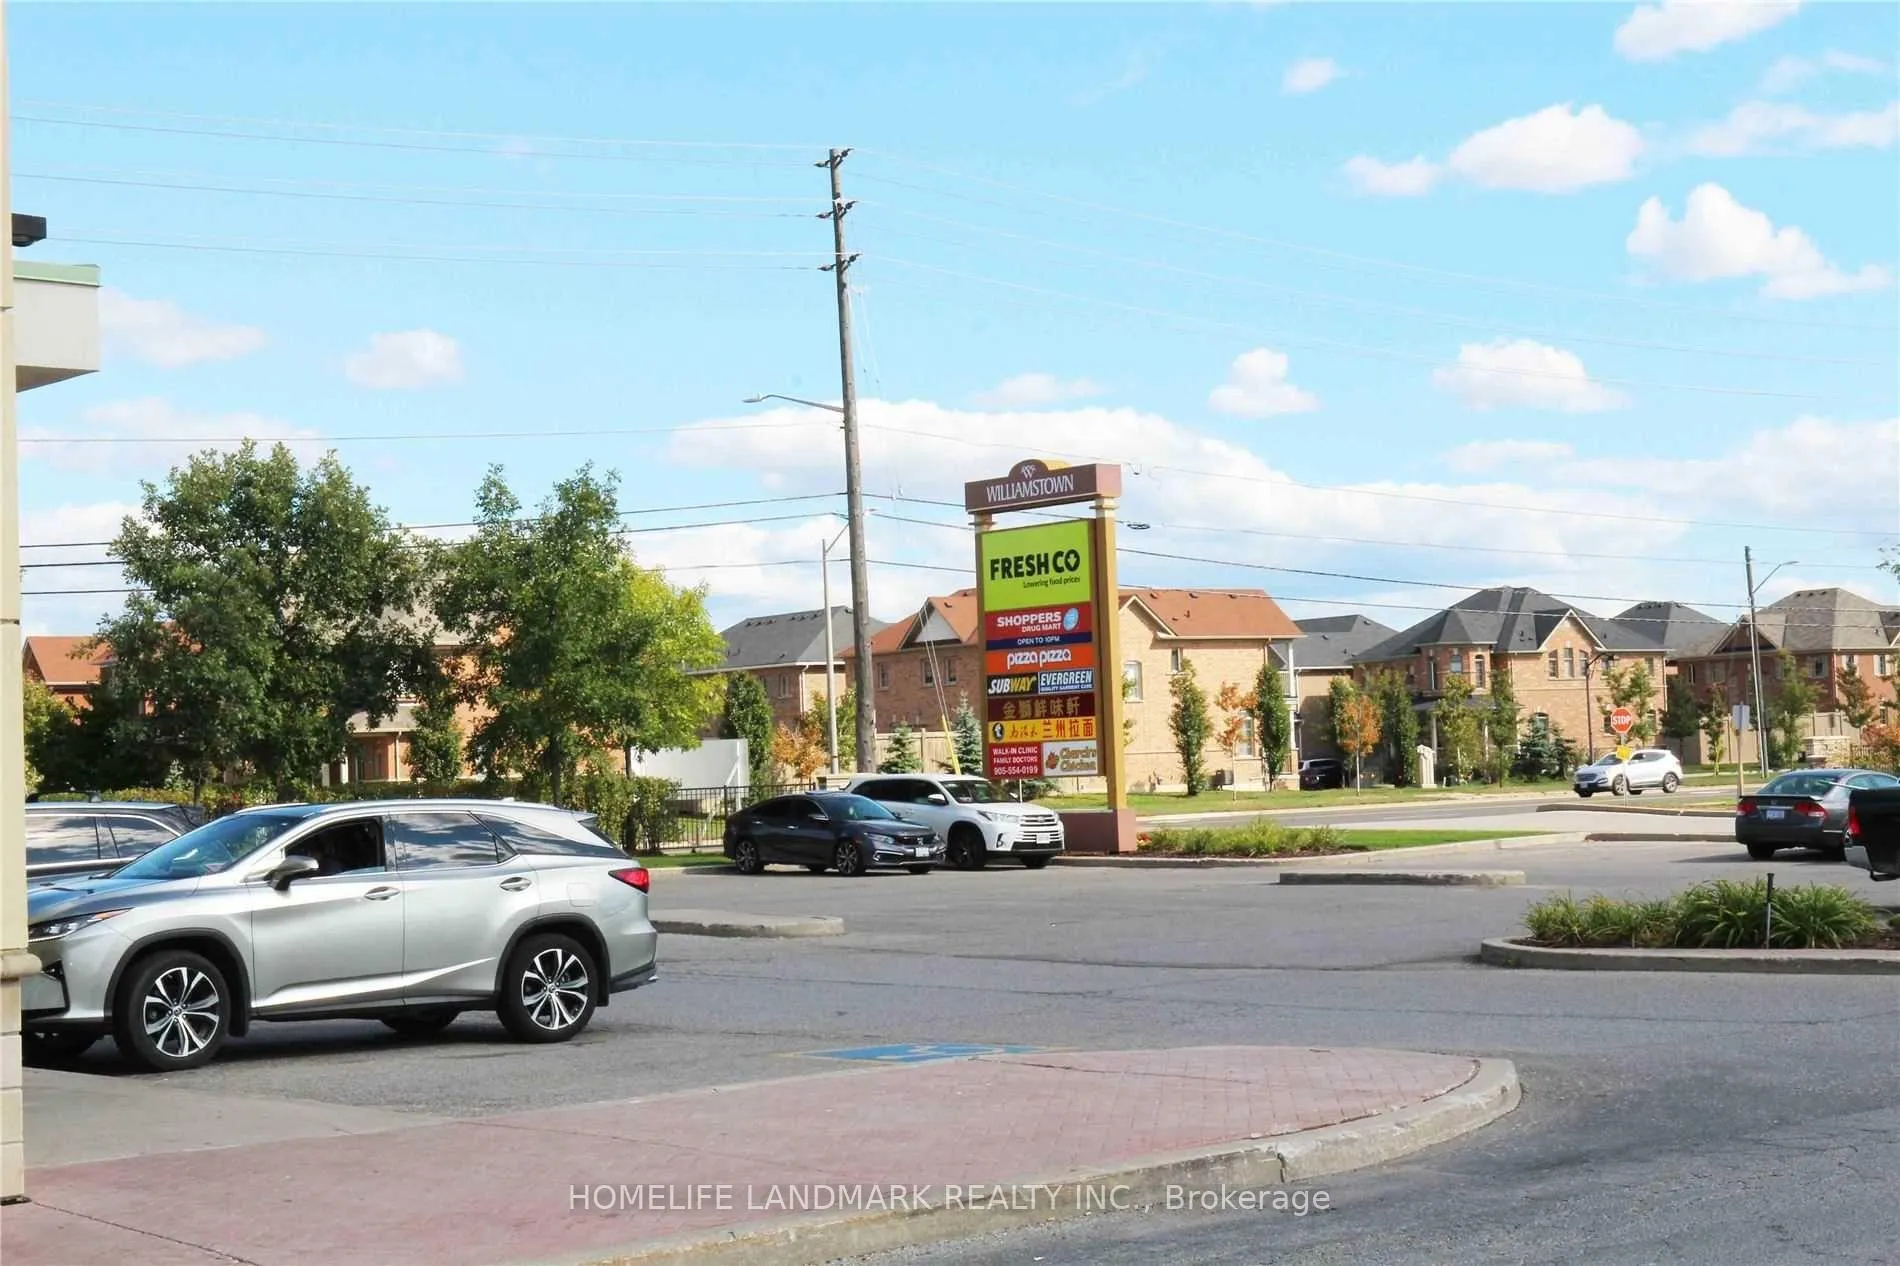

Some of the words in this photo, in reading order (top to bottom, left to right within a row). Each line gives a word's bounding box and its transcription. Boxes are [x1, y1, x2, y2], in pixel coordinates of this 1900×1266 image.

[986, 474, 1074, 503] WILLIAMSTOWN
[1023, 578, 1049, 588] Lowering
[1063, 576, 1080, 586] prices
[997, 611, 1062, 627] SHOPPERS
[1022, 624, 1041, 633] DRUG
[1042, 623, 1061, 631] MART
[1017, 637, 1034, 645] OPEN
[1035, 636, 1044, 644] TO
[1007, 651, 1038, 669] pizza
[1040, 648, 1071, 667] pizza
[988, 675, 1036, 695] SUBWAY
[1041, 670, 1092, 685] EVERGREEN
[1612, 714, 1632, 725] STOP
[1043, 719, 1093, 739] 兰州拉面
[992, 747, 1017, 755] WALK-IN
[1018, 746, 1038, 754] CLINIC
